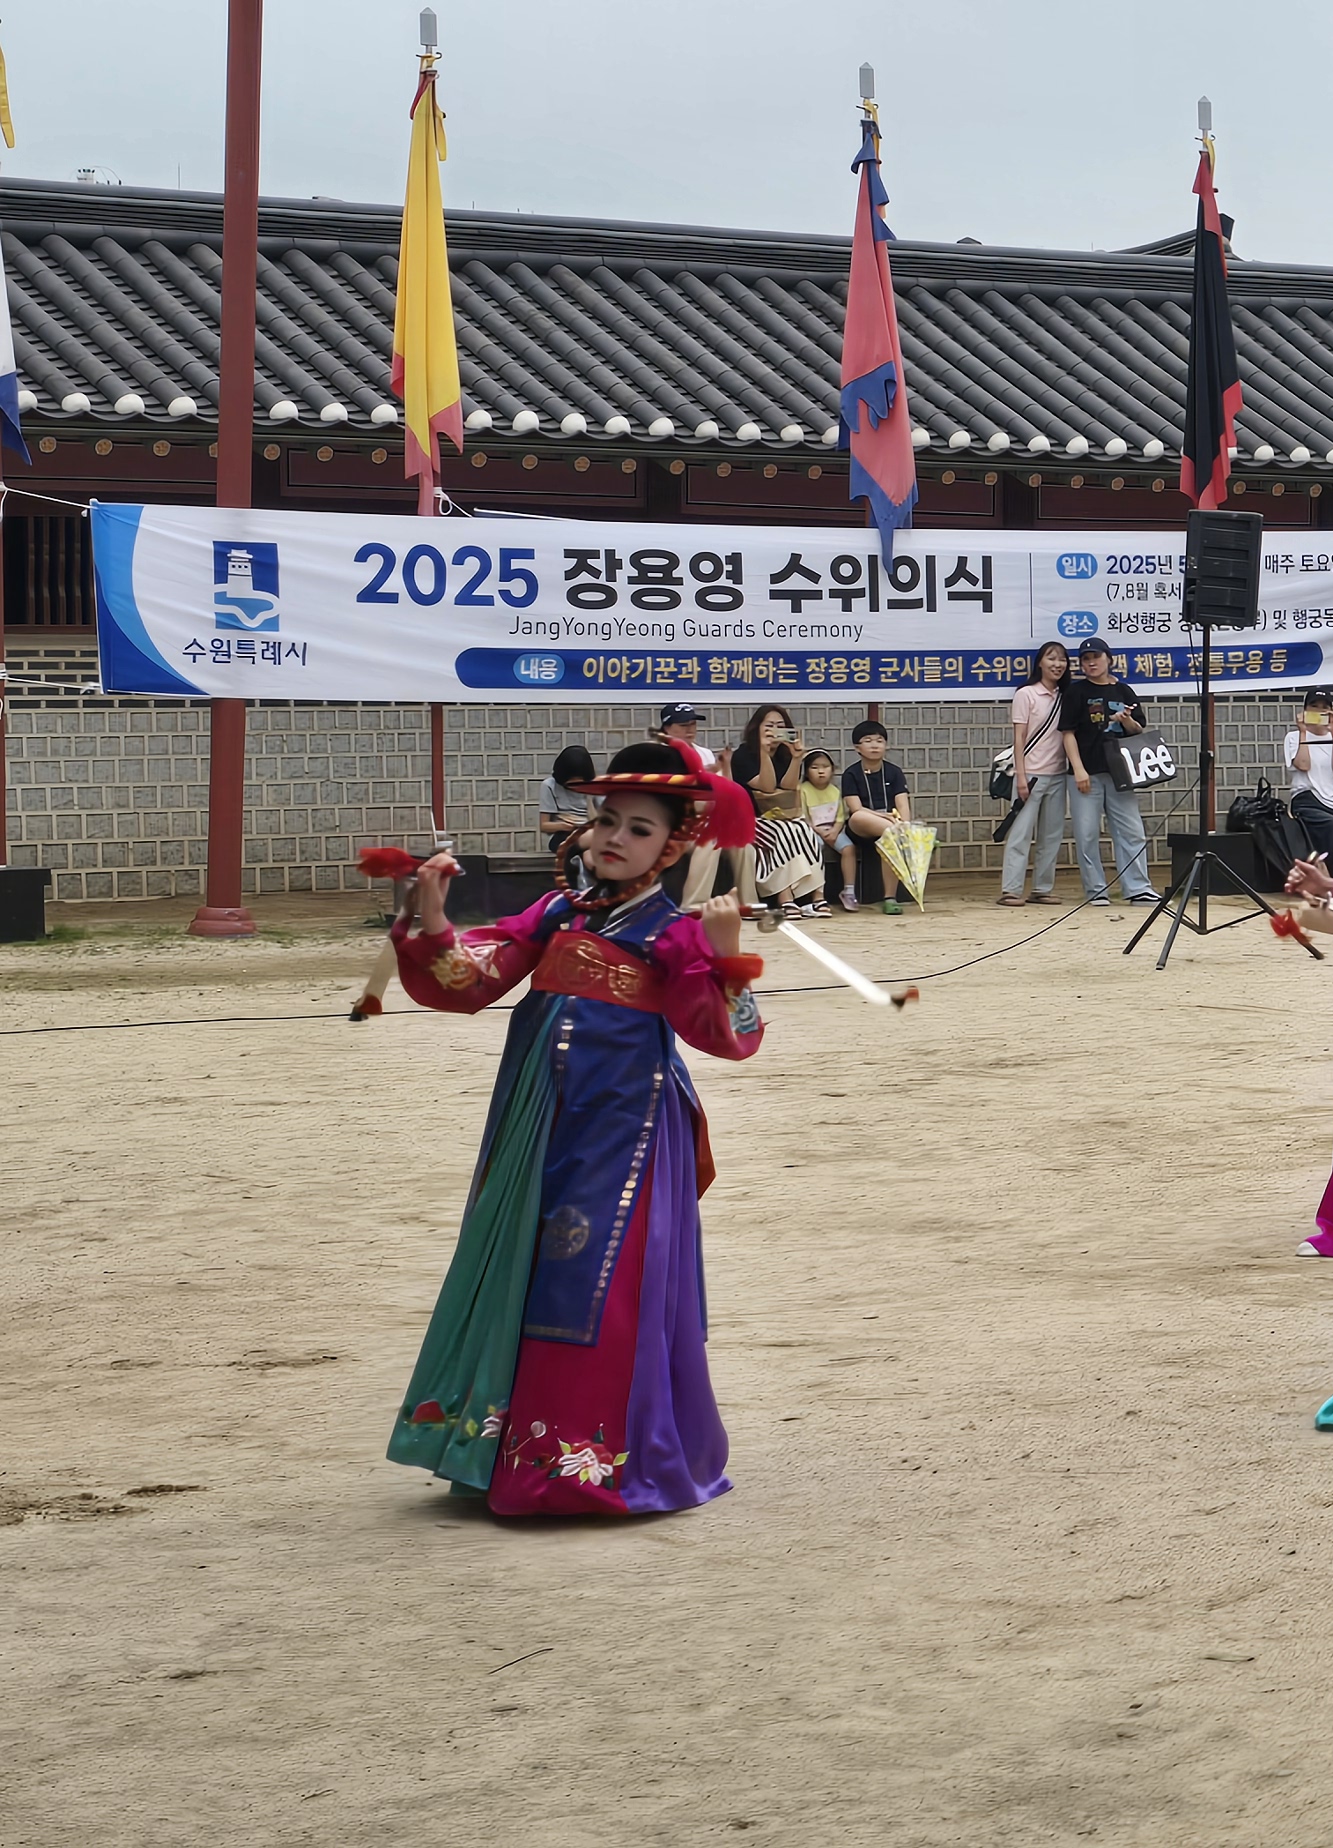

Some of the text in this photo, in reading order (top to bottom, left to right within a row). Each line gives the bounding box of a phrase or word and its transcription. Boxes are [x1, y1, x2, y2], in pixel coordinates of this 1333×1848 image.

[1062, 556, 1092, 577] 일시
[1106, 554, 1172, 575] 2025년
[1264, 554, 1295, 573] 매주
[353, 542, 993, 613] 2025 장용영 수위의식
[1154, 582, 1182, 600] 혹서
[508, 616, 863, 643] JangYongYeong Guards Ceremony
[1062, 615, 1094, 635] 장소
[1107, 612, 1172, 633] 화성행궁
[1273, 609, 1287, 630] 및
[182, 637, 308, 666] 수원특례시
[520, 657, 558, 681] 내용
[582, 655, 701, 684] 이야기꾼과
[707, 656, 799, 684] 함께하는
[805, 656, 871, 684] 장용영
[878, 656, 963, 683] 군사들의
[970, 655, 1031, 682] 수위의
[1134, 652, 1180, 678] 체험,
[1270, 649, 1287, 673] 등
[1120, 744, 1176, 784] Lee
